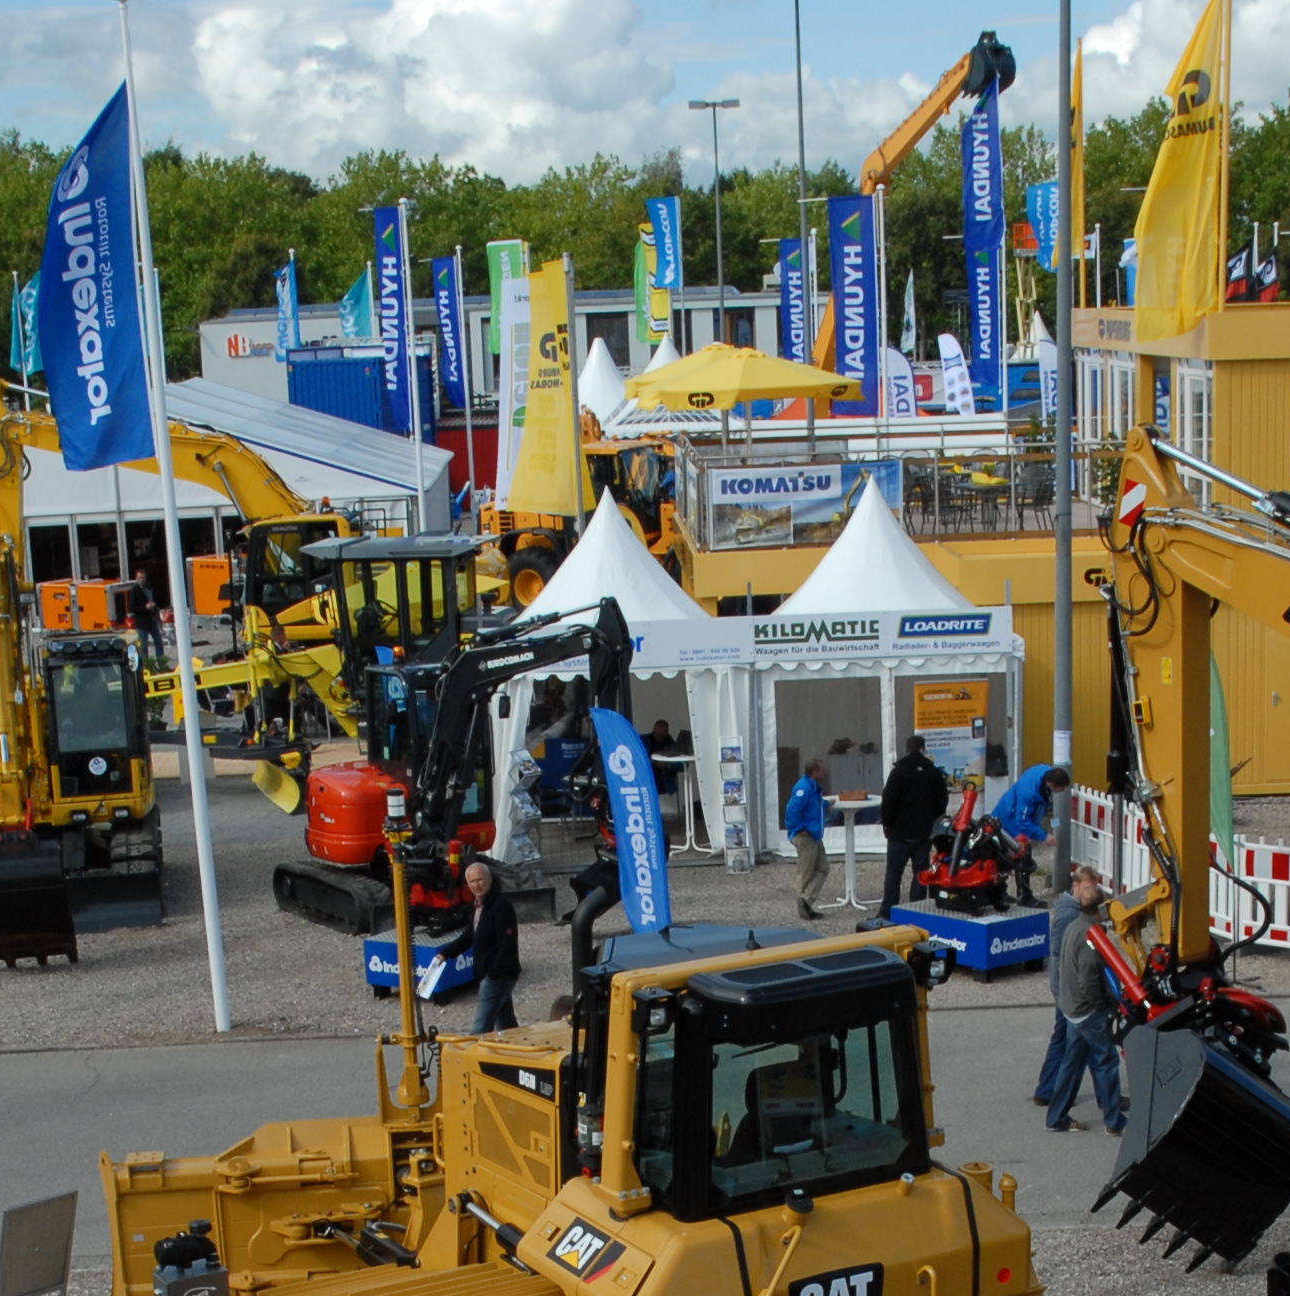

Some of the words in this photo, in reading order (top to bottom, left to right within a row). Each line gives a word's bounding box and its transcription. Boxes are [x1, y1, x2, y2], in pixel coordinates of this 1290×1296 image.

[719, 470, 833, 497] KOMATSU
[904, 618, 987, 633] LOADRITE
[755, 647, 789, 656] Waagen
[821, 643, 880, 653] Bauwirtschaft
[1002, 933, 1047, 952] Indexator
[555, 1225, 605, 1271] CAT
